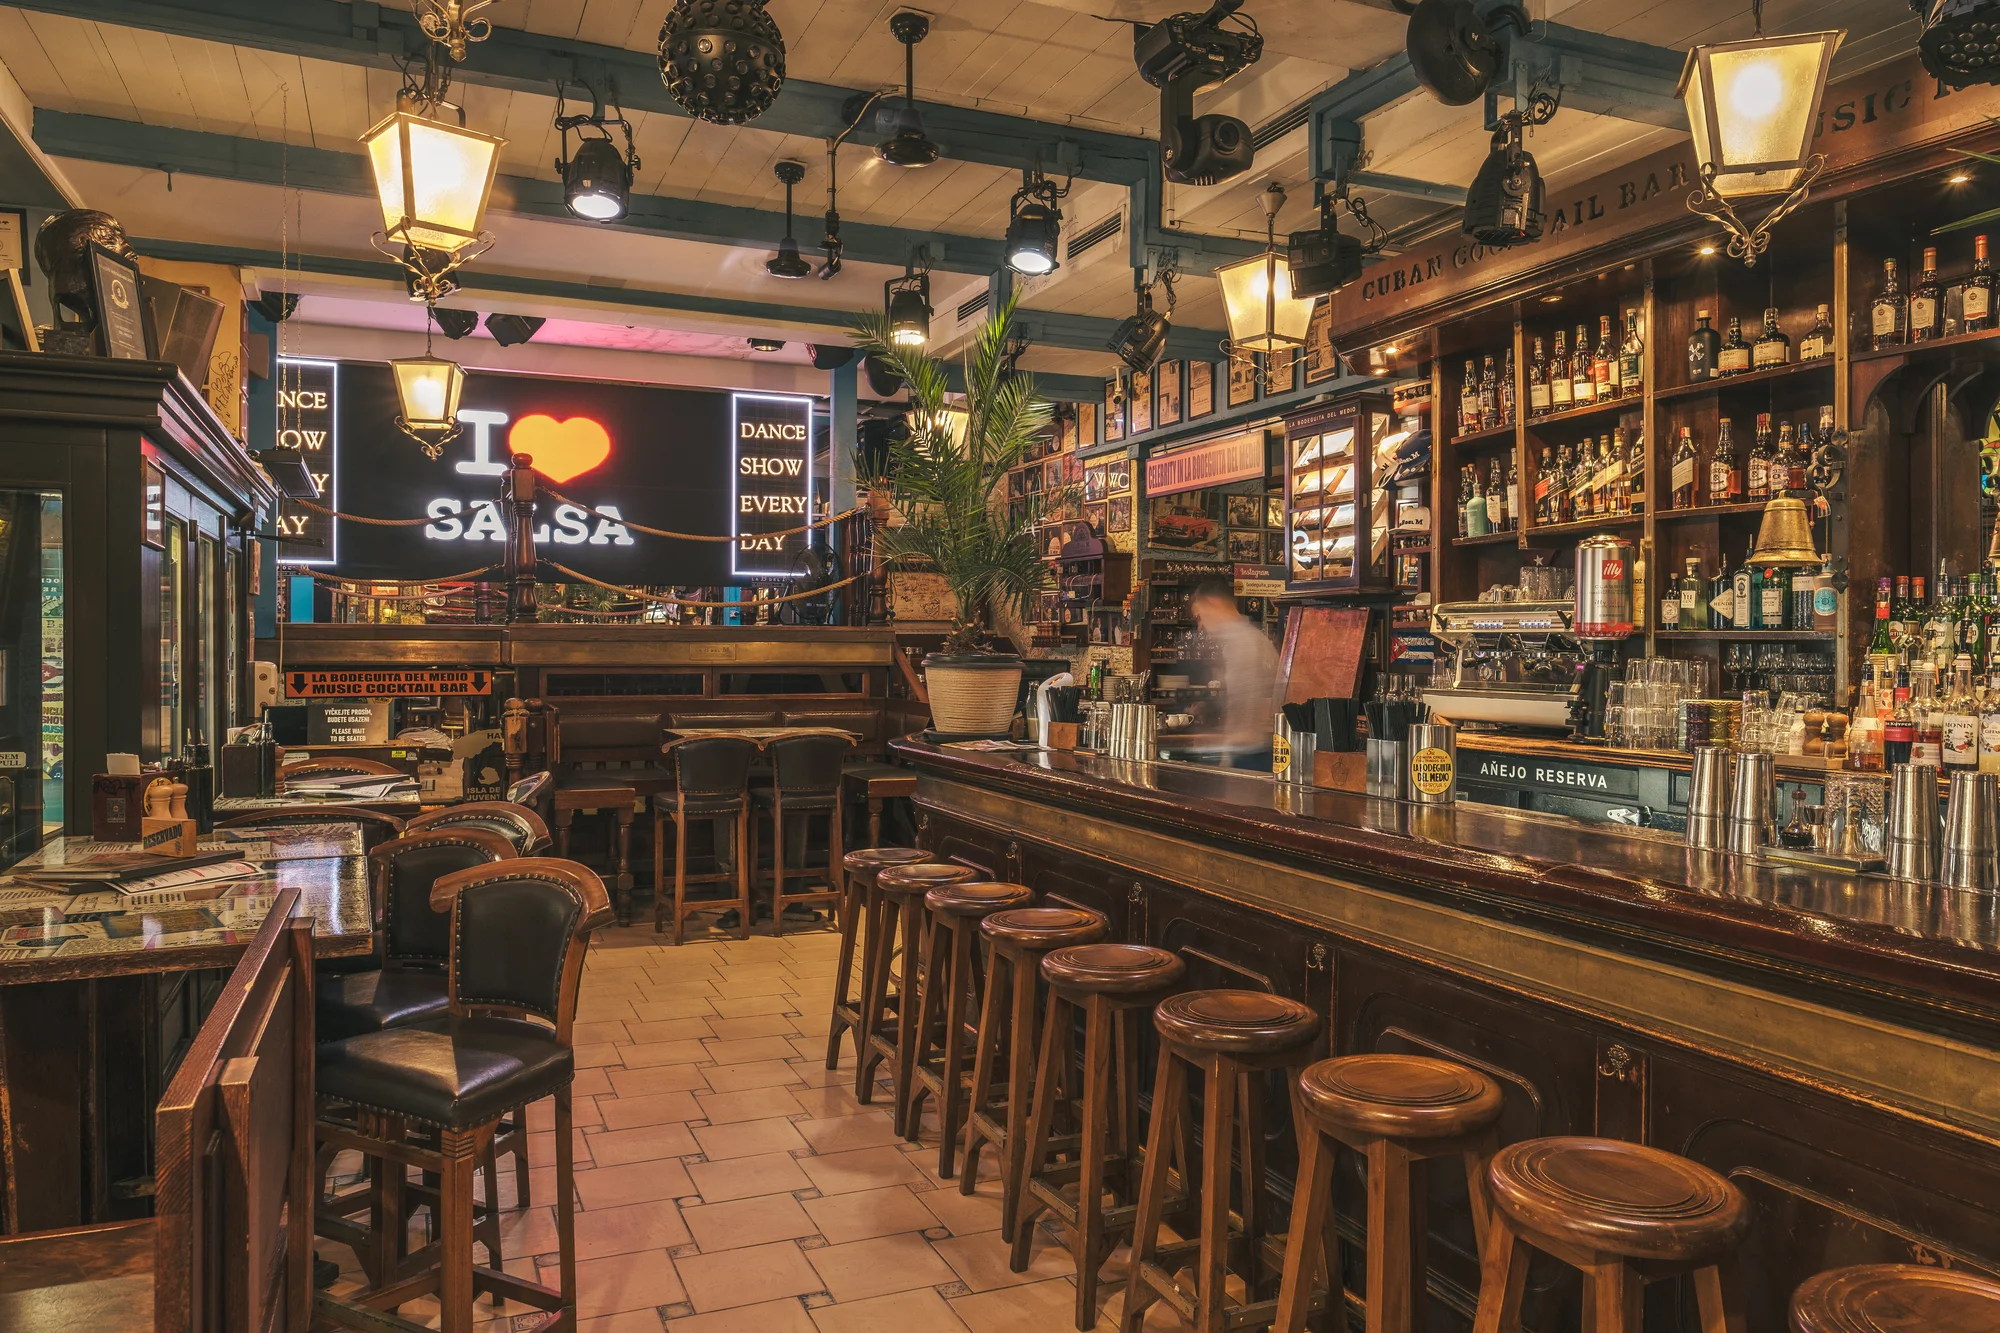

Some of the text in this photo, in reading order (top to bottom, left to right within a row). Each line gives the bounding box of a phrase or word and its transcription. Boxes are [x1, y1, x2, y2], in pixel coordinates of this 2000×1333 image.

[1362, 253, 1443, 301] CUBAN
[1617, 161, 1691, 210] BAR
[277, 390, 328, 409] NCE
[1297, 414, 1325, 426] BODEGUITA
[1326, 411, 1337, 419] DEL
[1339, 406, 1357, 416] MEDIO
[739, 422, 807, 440] DANCE
[455, 408, 509, 476] I
[739, 457, 804, 476] SHOW
[1148, 440, 1261, 490] CELEBRITY IN LA BODEGUITA DEL MEDIO
[739, 494, 808, 513] EVERY
[739, 533, 786, 550] DAY
[1240, 567, 1270, 579] Instagram
[1603, 562, 1622, 579] illy
[312, 673, 468, 683] LA BODEGUITA DEL MEDIO
[312, 683, 469, 694] MUSIC COCKTAIL BAR
[324, 708, 350, 716] VYČKEJTE
[1413, 763, 1419, 772] LA
[1417, 772, 1450, 782] DEL MEDIO
[1535, 768, 1608, 789] RESERVA
[142, 823, 183, 851] RESERVADO
